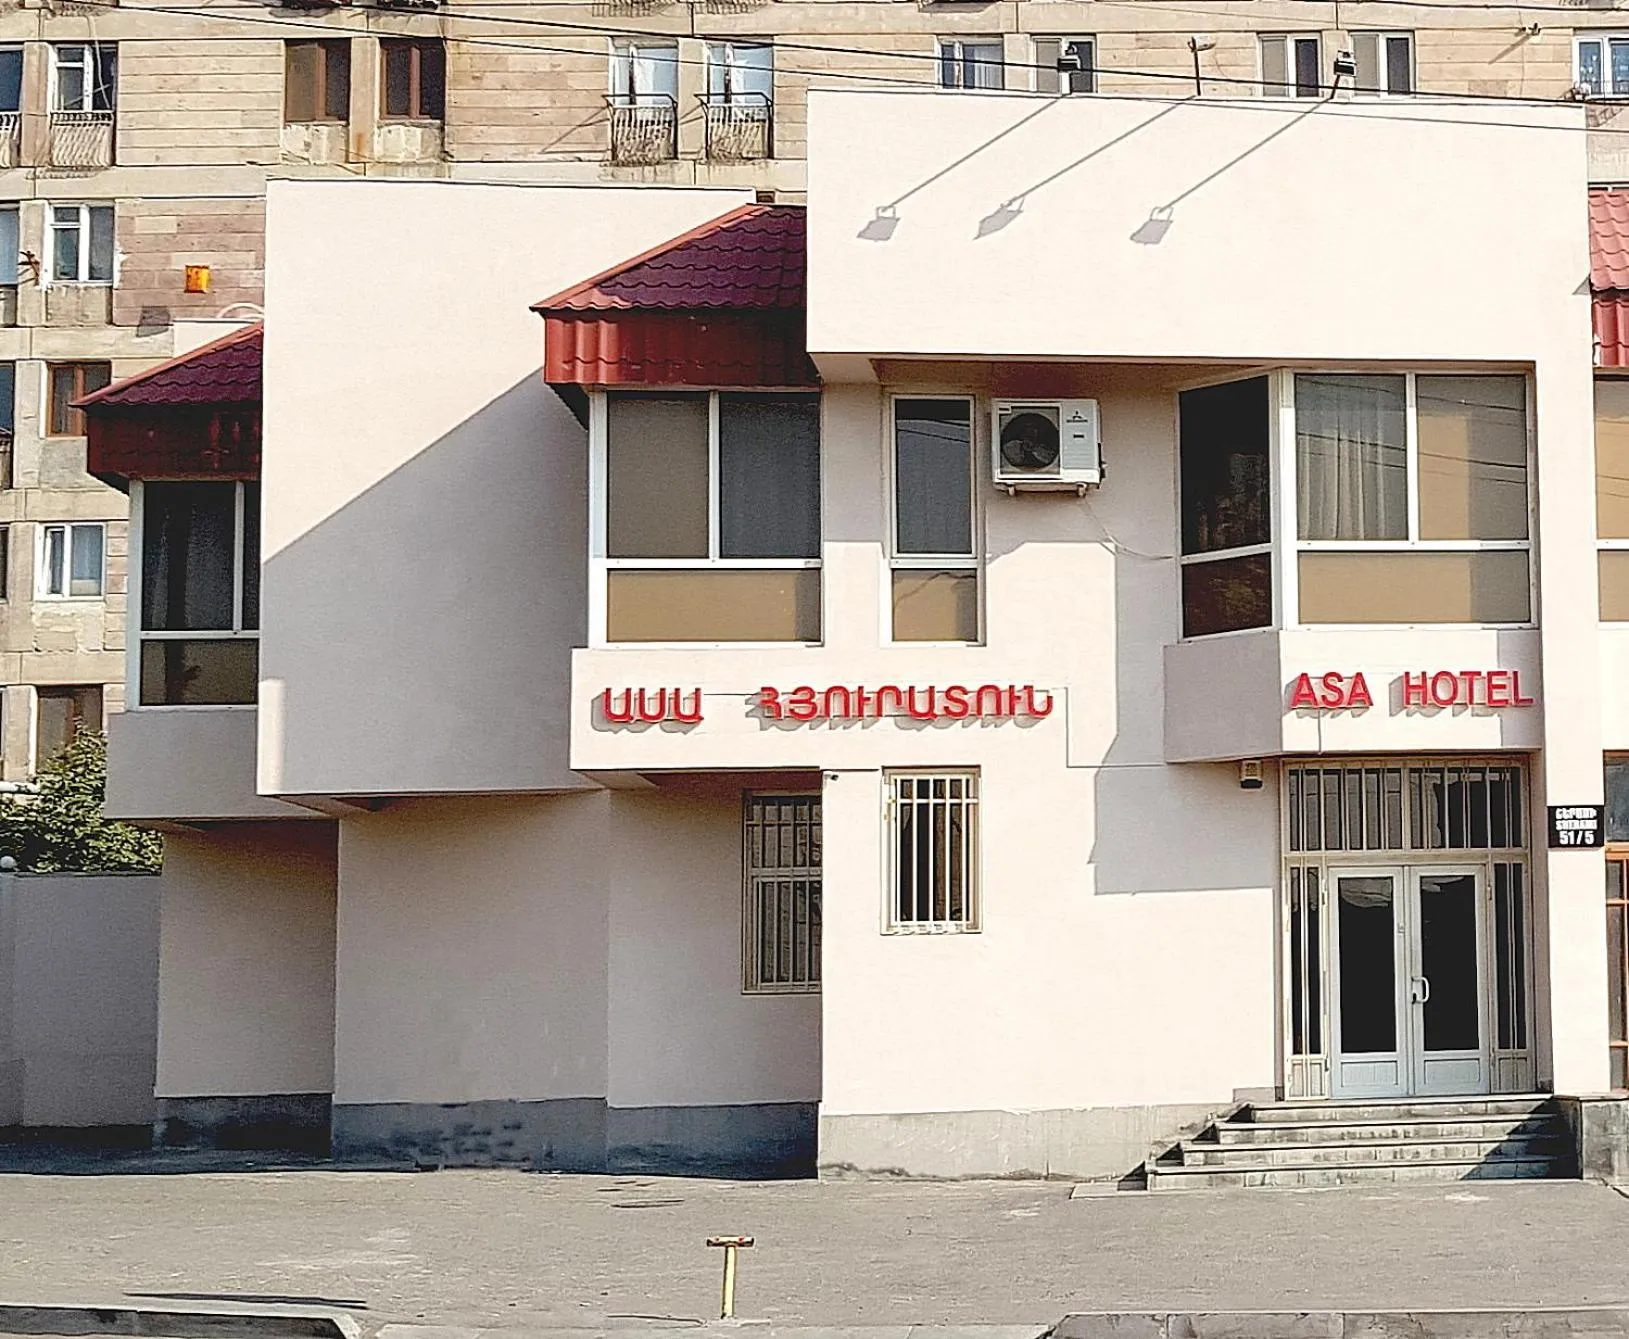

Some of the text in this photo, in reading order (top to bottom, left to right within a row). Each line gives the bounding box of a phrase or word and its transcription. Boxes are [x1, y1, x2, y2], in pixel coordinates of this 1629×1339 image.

[604, 685, 1054, 722] ԱՍԱ ՀՅՈՒՐԱՏՈՒՆ
[1290, 670, 1535, 708] ASA HOTEL
